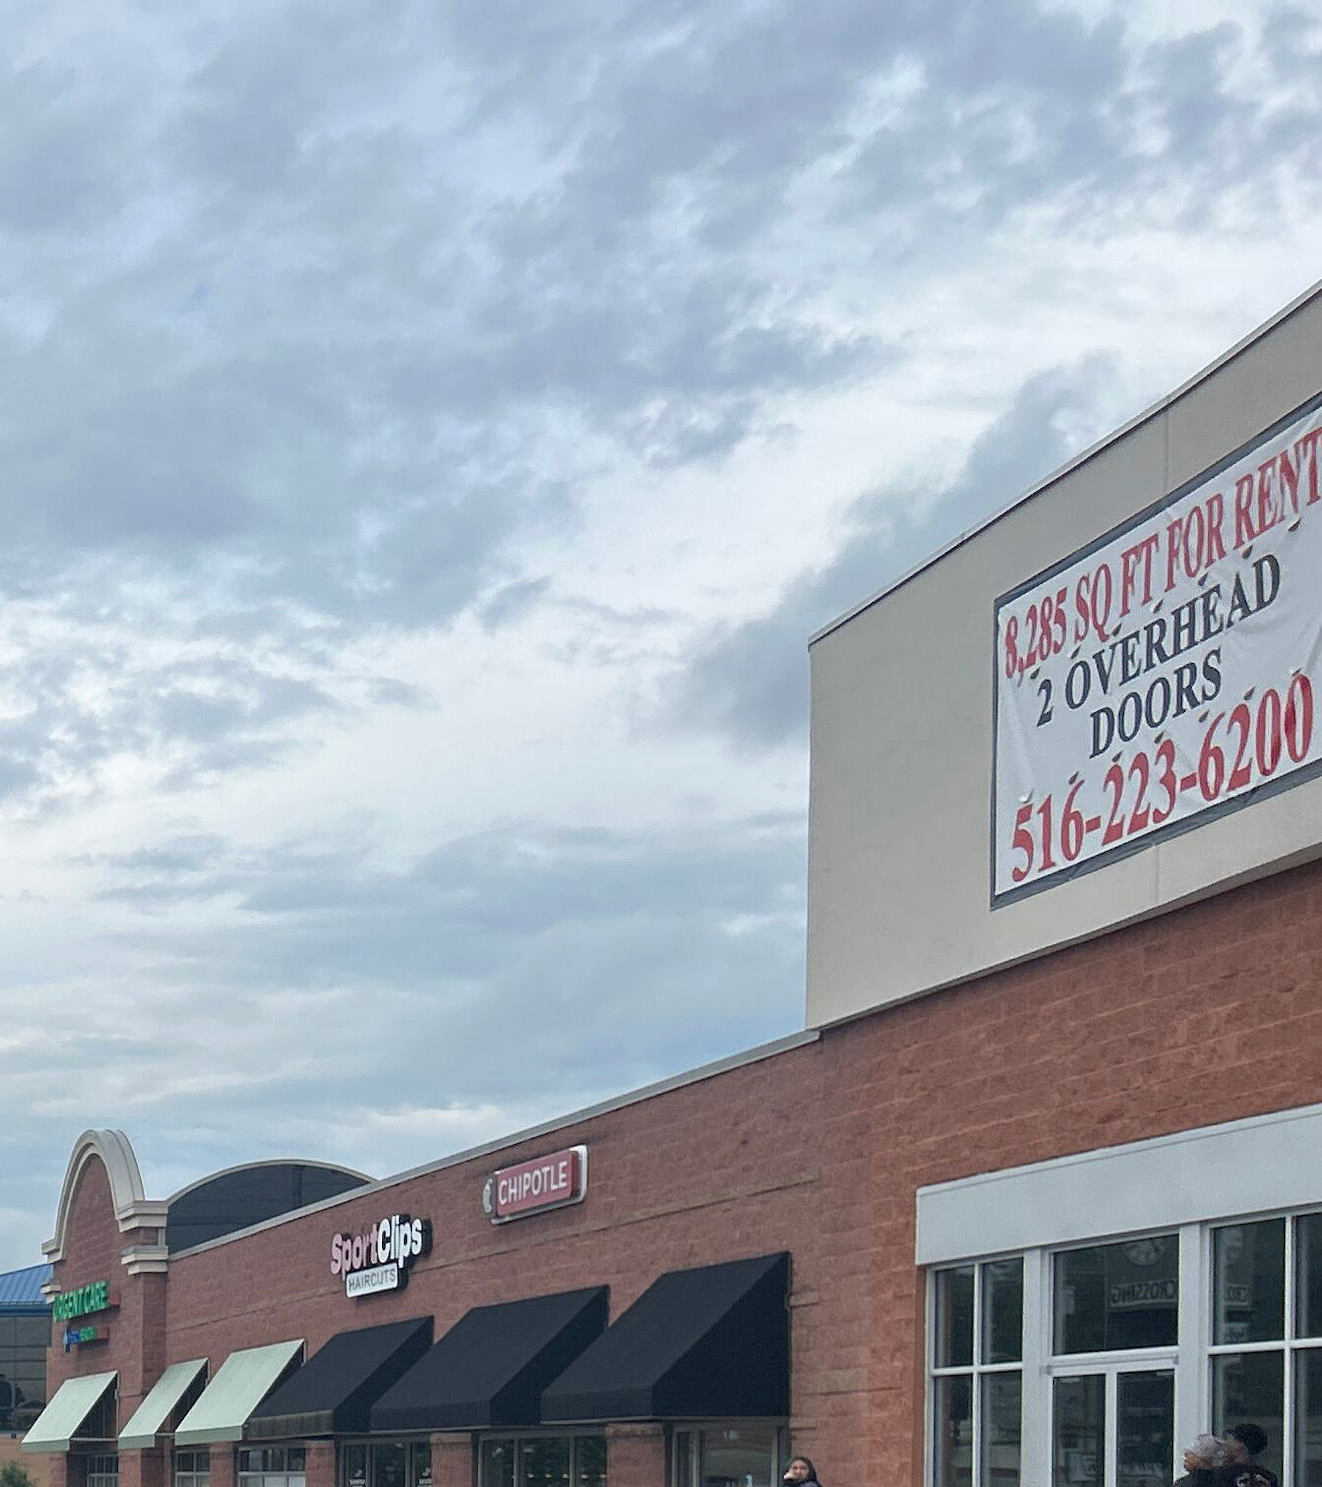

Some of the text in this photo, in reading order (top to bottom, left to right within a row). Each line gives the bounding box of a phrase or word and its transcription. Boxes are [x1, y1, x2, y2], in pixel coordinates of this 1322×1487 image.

[1005, 426, 1322, 687] 8,285 SQ FT FOR RENT
[1036, 554, 1281, 727] 2 OVERHEAD
[1089, 646, 1222, 759] DOORS
[1011, 673, 1313, 882] 516-223-6200
[498, 1161, 567, 1205] CHIPOTLE
[348, 1270, 396, 1291] HAIRCUTS
